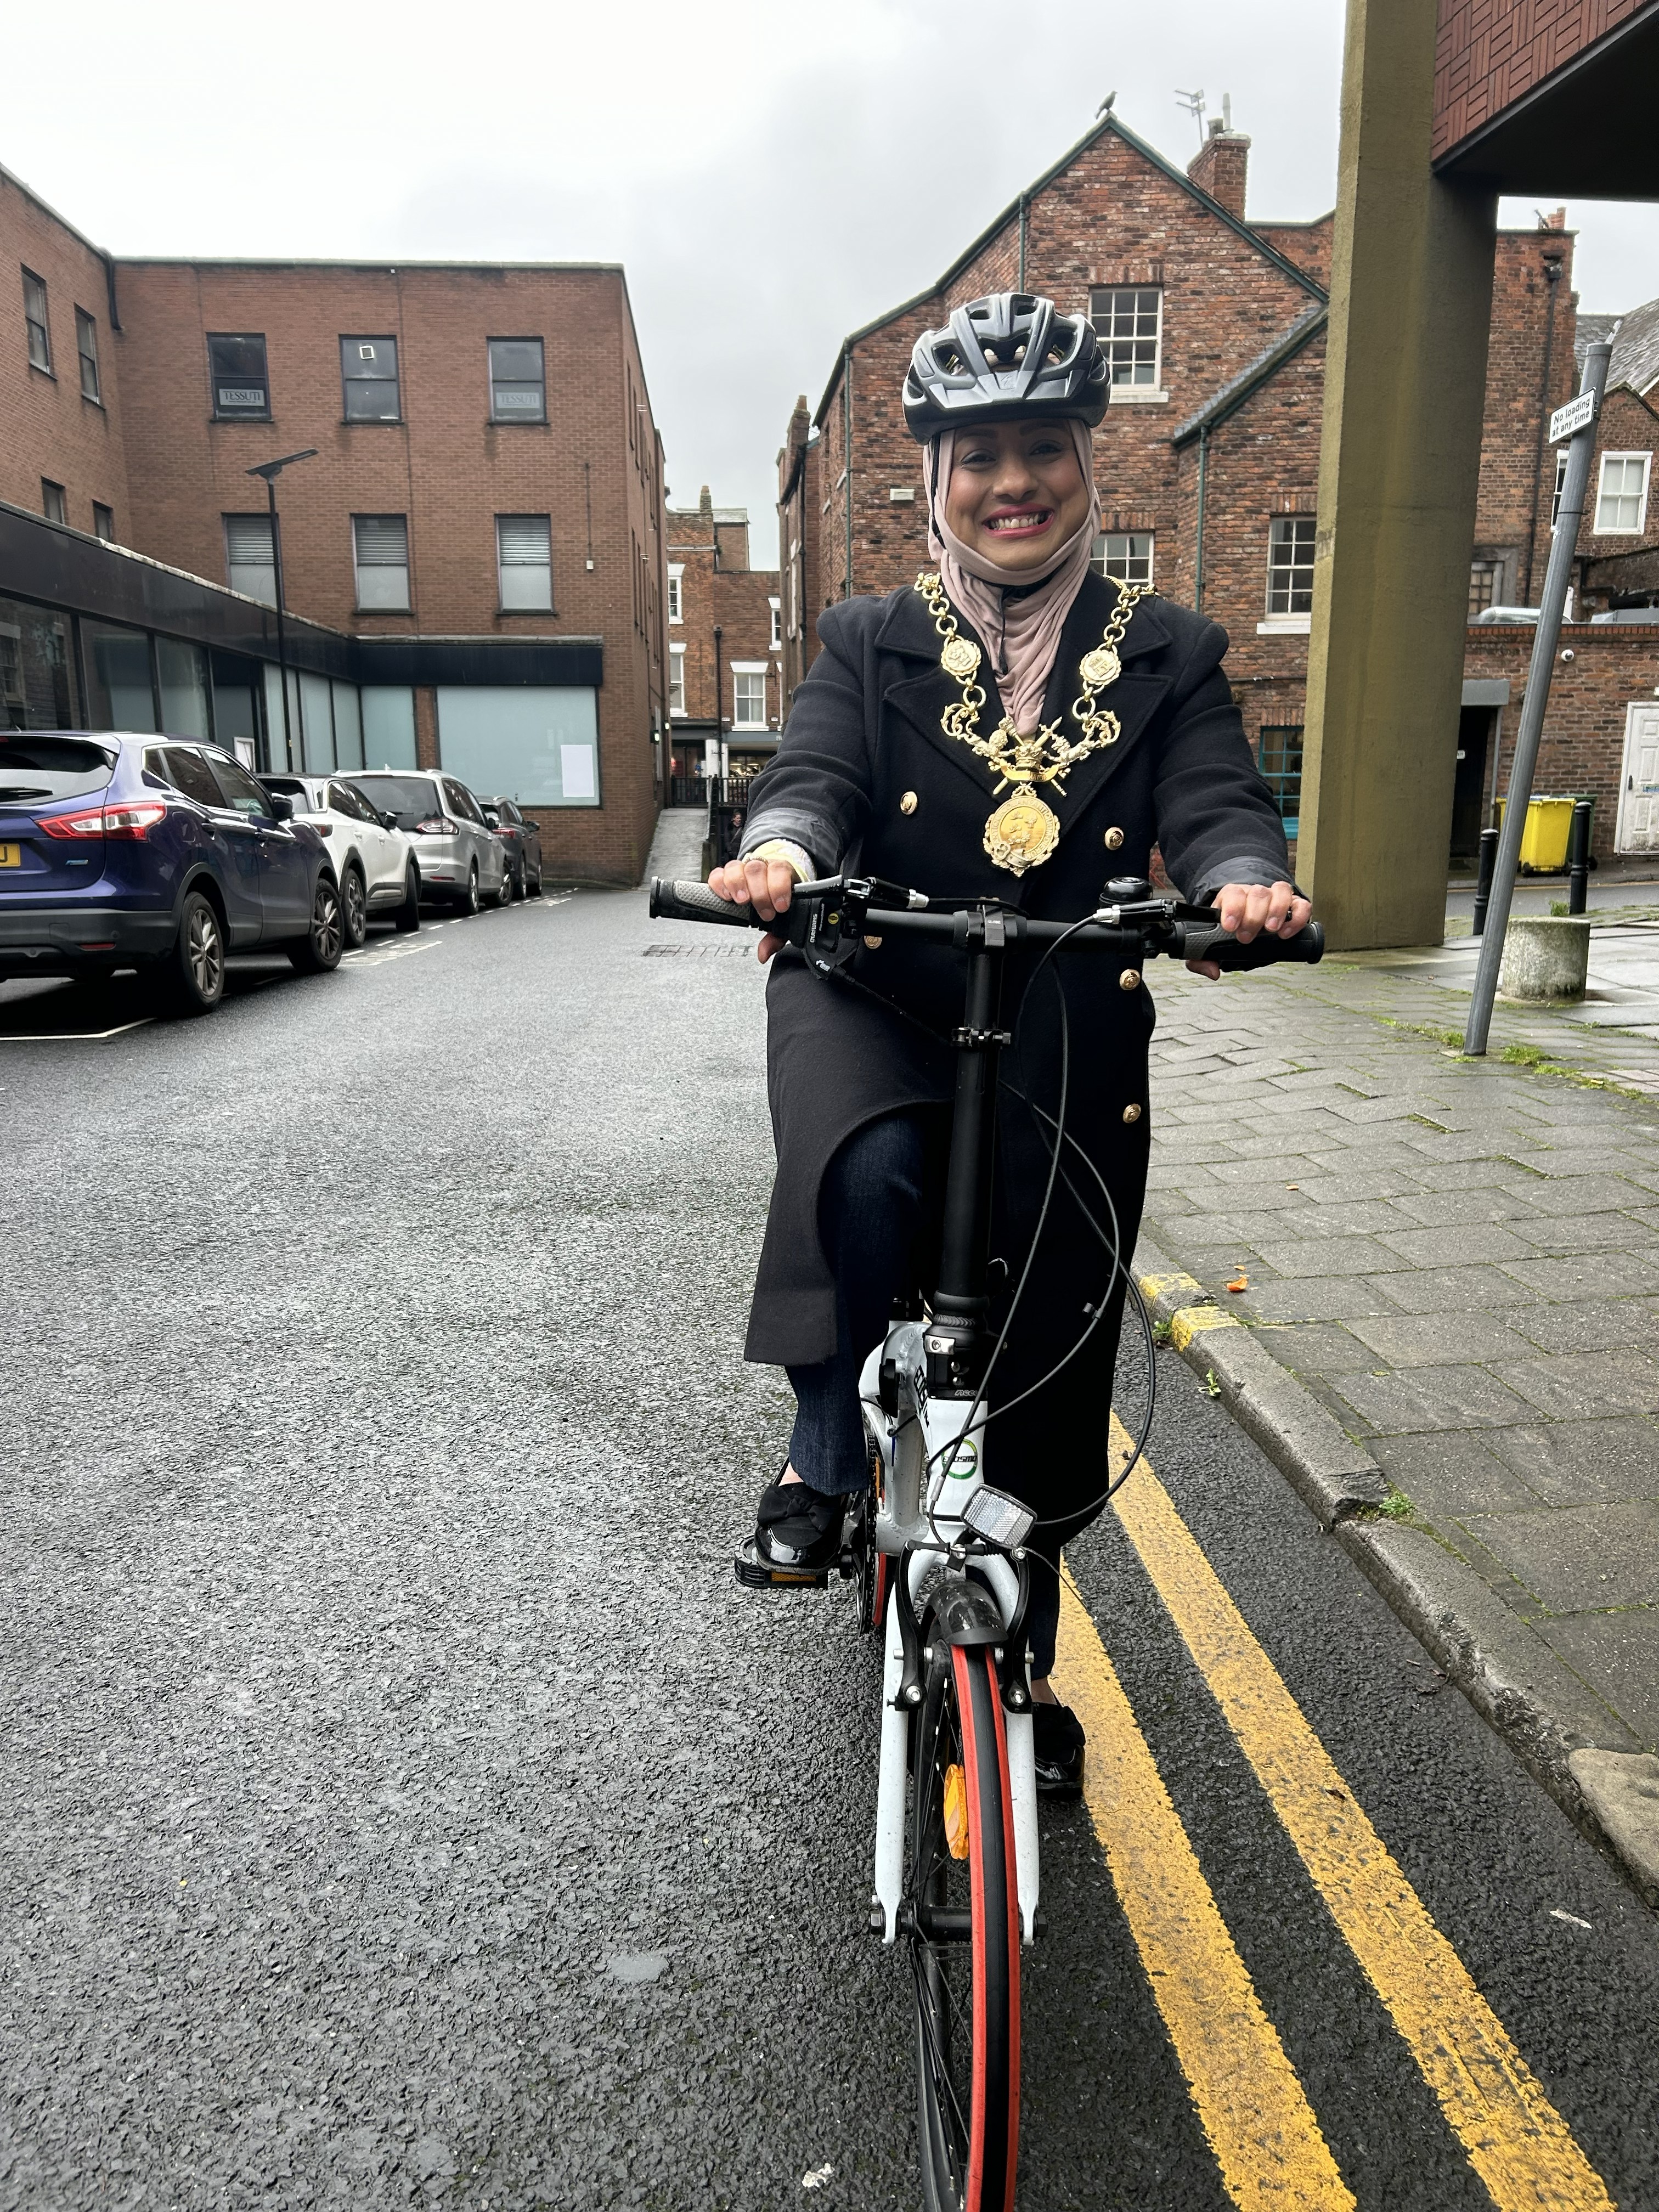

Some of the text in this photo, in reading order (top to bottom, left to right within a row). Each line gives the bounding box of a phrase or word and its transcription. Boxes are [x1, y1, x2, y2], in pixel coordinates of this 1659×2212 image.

[223, 391, 260, 400] TESSUTI
[500, 394, 537, 404] TESSUTI
[1552, 410, 1590, 437] at any time
[1554, 398, 1590, 425] No loading
[810, 913, 818, 943] SHIMANO
